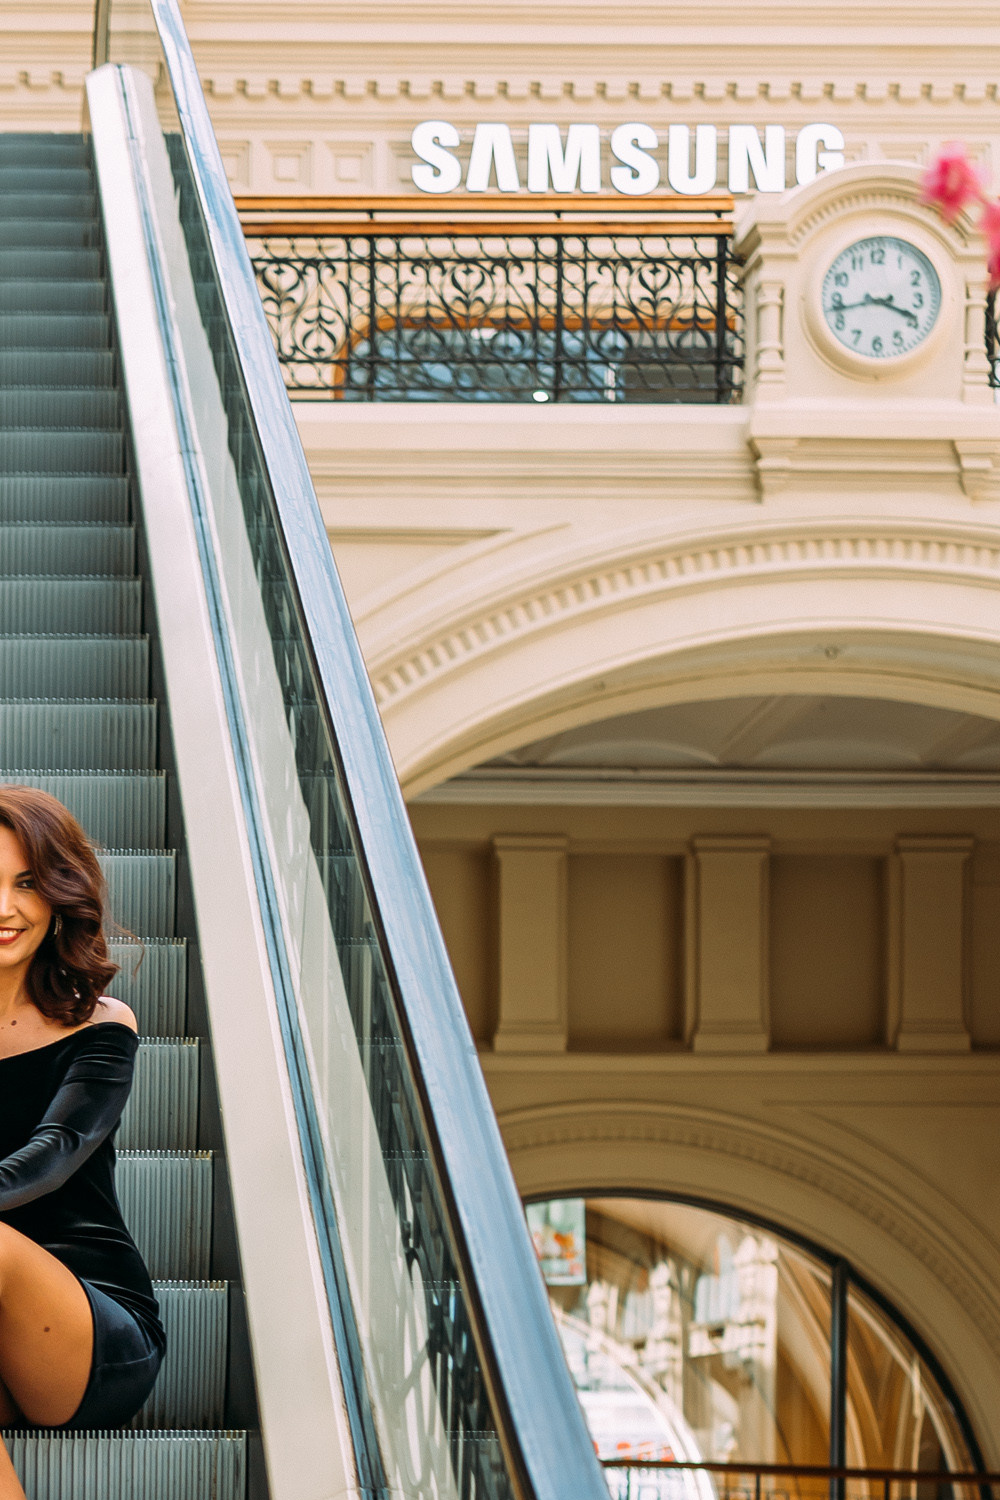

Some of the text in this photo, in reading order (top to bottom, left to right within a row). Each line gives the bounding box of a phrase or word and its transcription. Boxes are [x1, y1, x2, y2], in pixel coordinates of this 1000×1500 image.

[411, 120, 845, 195] SAMSUNG
[852, 255, 863, 271] 11
[870, 249, 885, 266] 12
[834, 272, 849, 288] 10
[910, 270, 921, 287] 2
[913, 293, 923, 309] 3
[851, 330, 862, 346] 7
[872, 336, 883, 352] 6
[892, 331, 904, 347] 5
